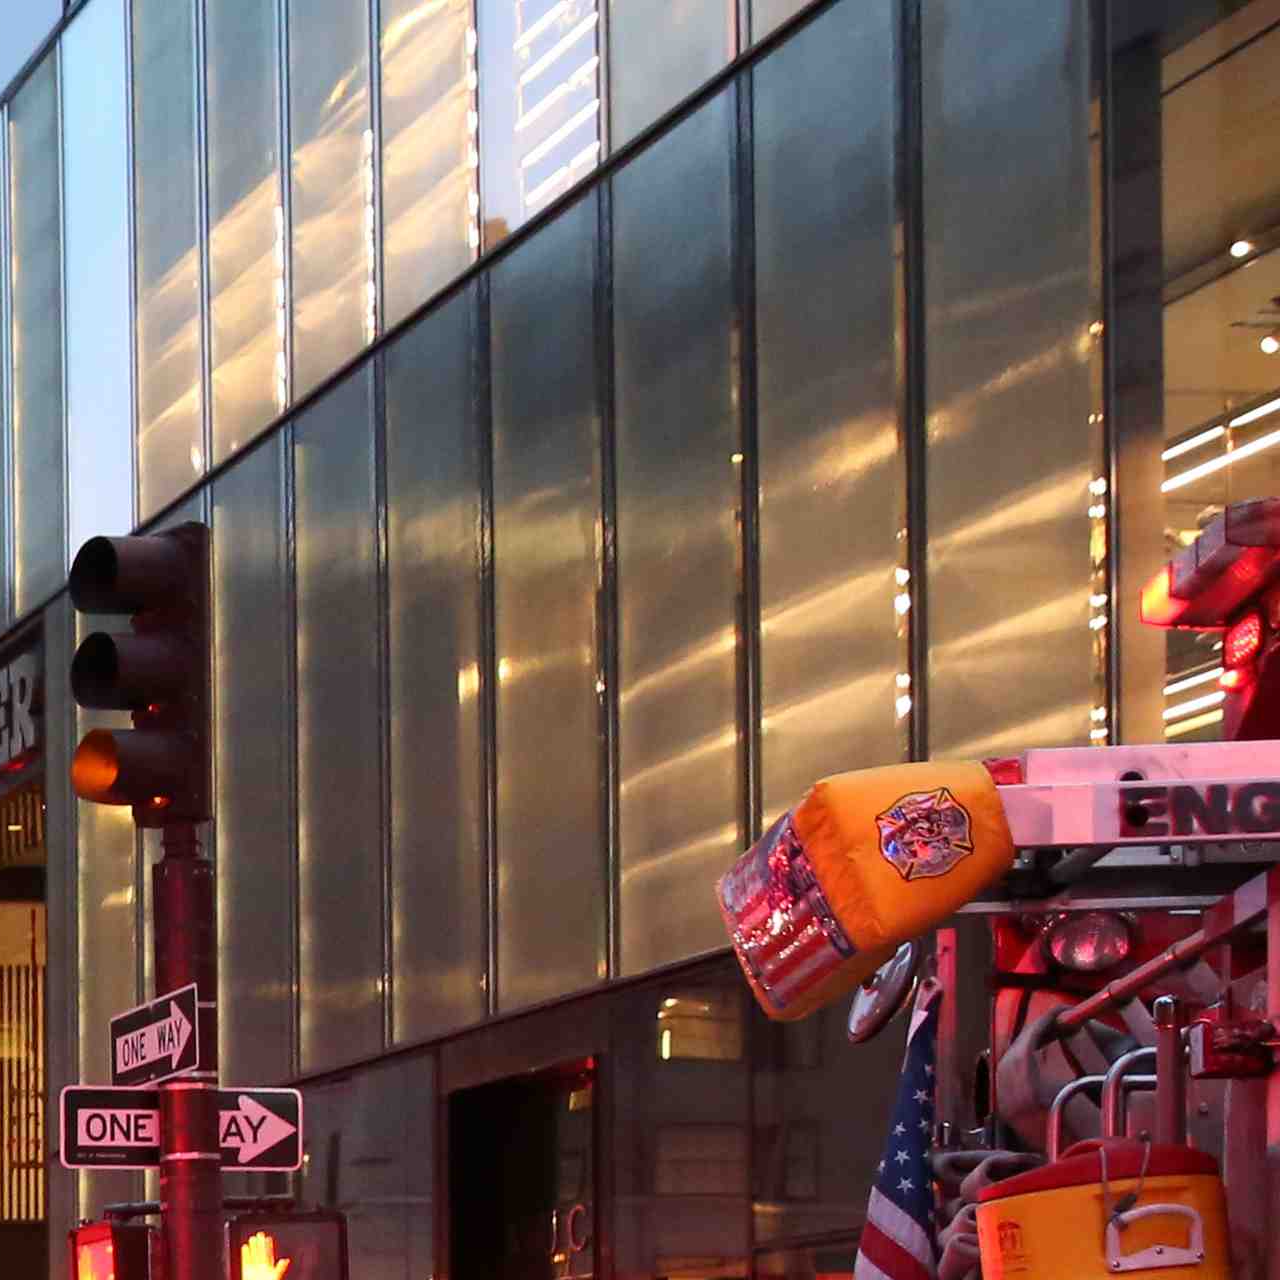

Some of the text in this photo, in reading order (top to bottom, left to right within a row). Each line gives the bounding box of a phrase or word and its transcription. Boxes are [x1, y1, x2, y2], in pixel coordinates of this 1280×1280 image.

[122, 1017, 184, 1067] ONE WAY
[85, 1112, 268, 1144] ONE AY
